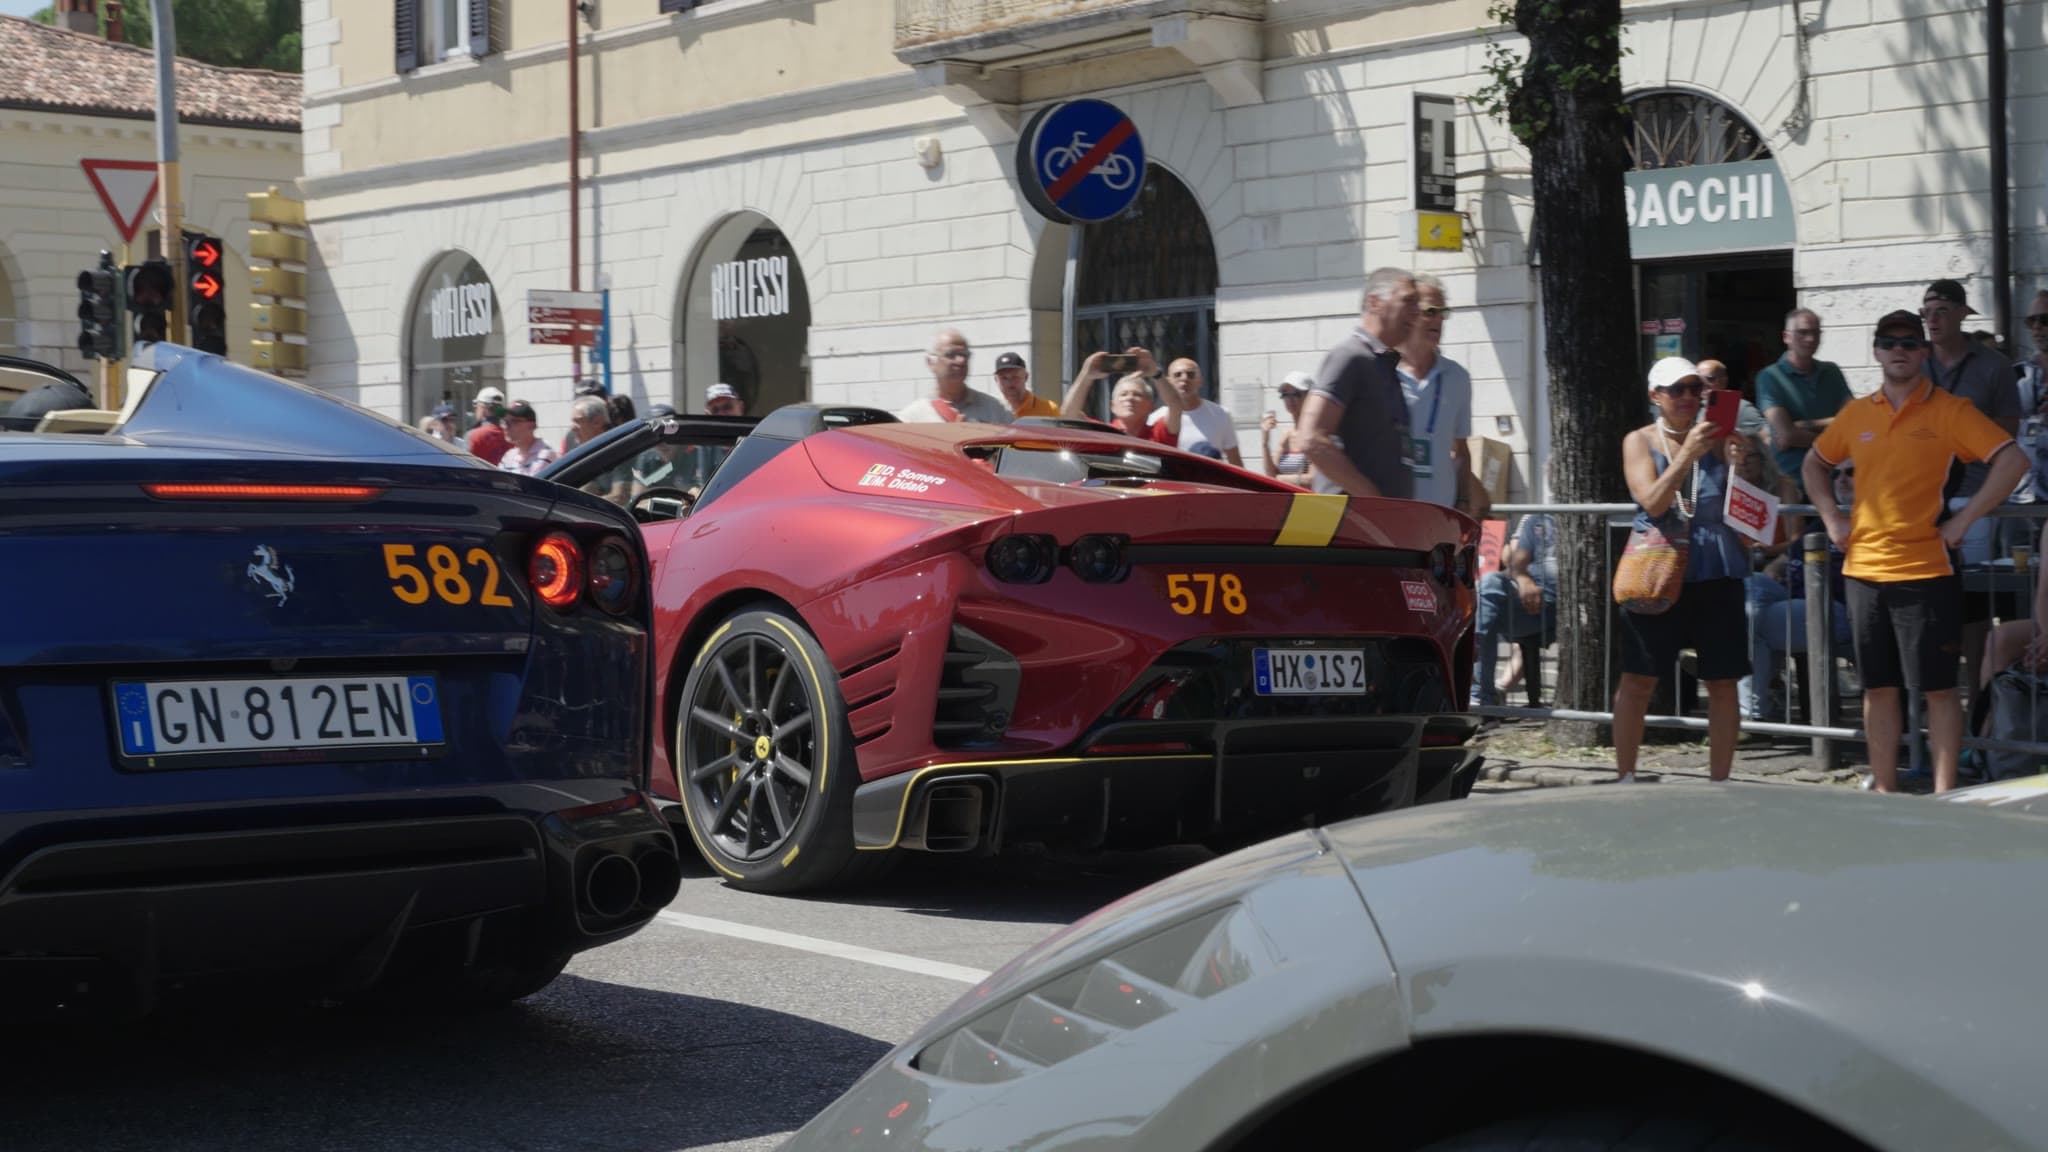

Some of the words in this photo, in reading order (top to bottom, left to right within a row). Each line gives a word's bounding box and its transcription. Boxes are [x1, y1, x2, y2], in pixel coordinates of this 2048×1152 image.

[431, 282, 492, 339] RIFLESSI
[711, 255, 789, 321] RIFLESSI
[382, 543, 515, 607] 582
[1166, 572, 1248, 615] 578
[1405, 584, 1428, 596] 1000
[1271, 654, 1302, 688] HX
[1320, 654, 1345, 688] IS
